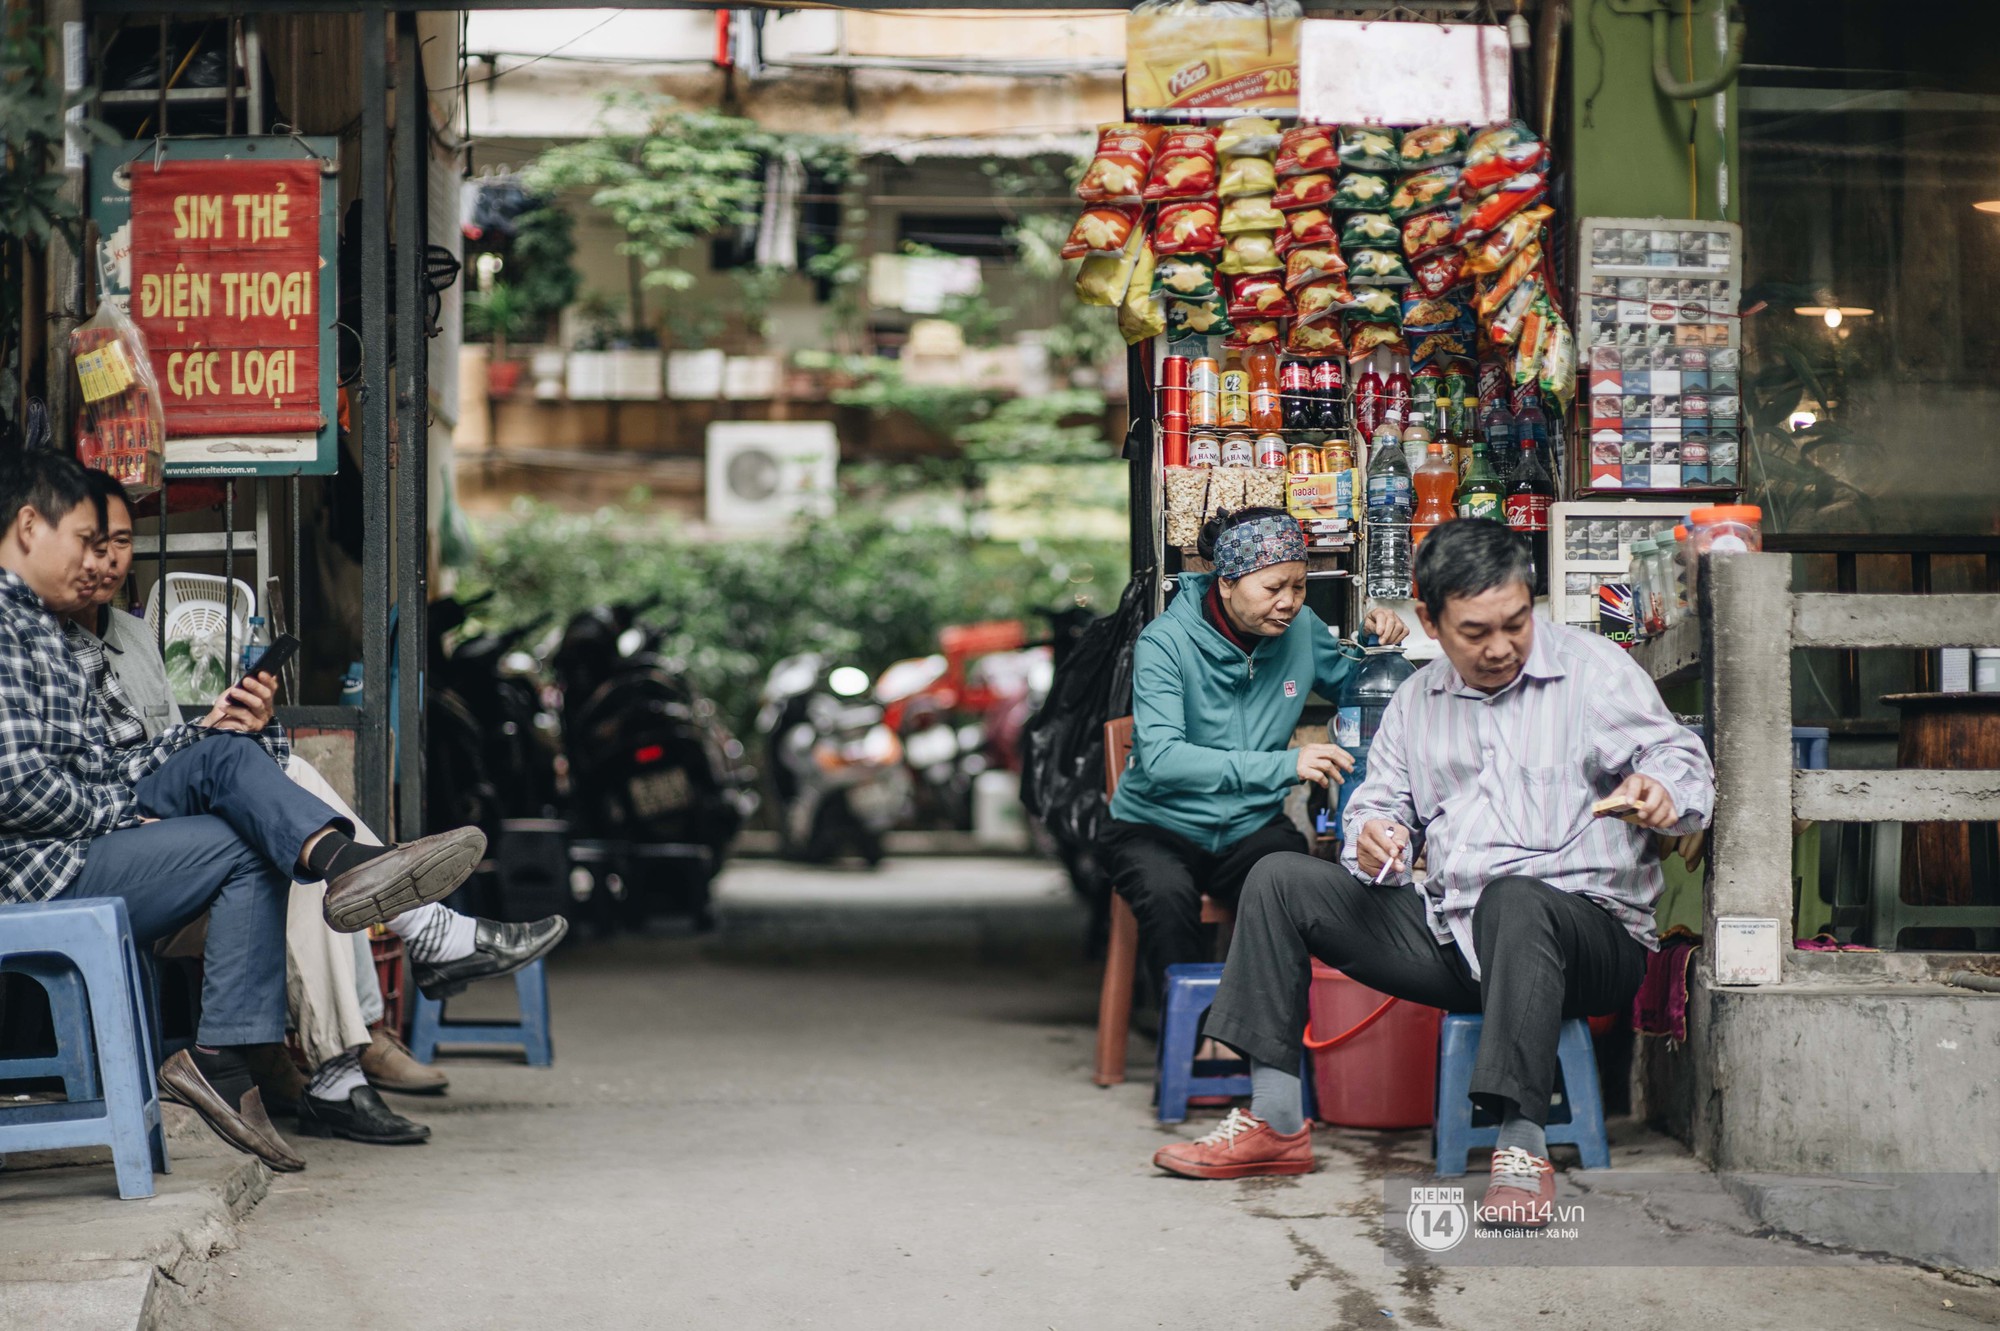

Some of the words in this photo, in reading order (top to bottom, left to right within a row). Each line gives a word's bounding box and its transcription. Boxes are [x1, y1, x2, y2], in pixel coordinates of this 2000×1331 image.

[173, 194, 223, 239] SIM
[232, 182, 291, 243] THẺ
[141, 263, 211, 332] ĐIỆN
[220, 271, 312, 331] THOẠI
[167, 342, 220, 401] CÁC
[231, 350, 296, 409] LOẠI
[165, 466, 257, 475] www.vietteltelecom.vn
[1292, 487, 1319, 497] nabati
[1471, 500, 1497, 518] Sprite
